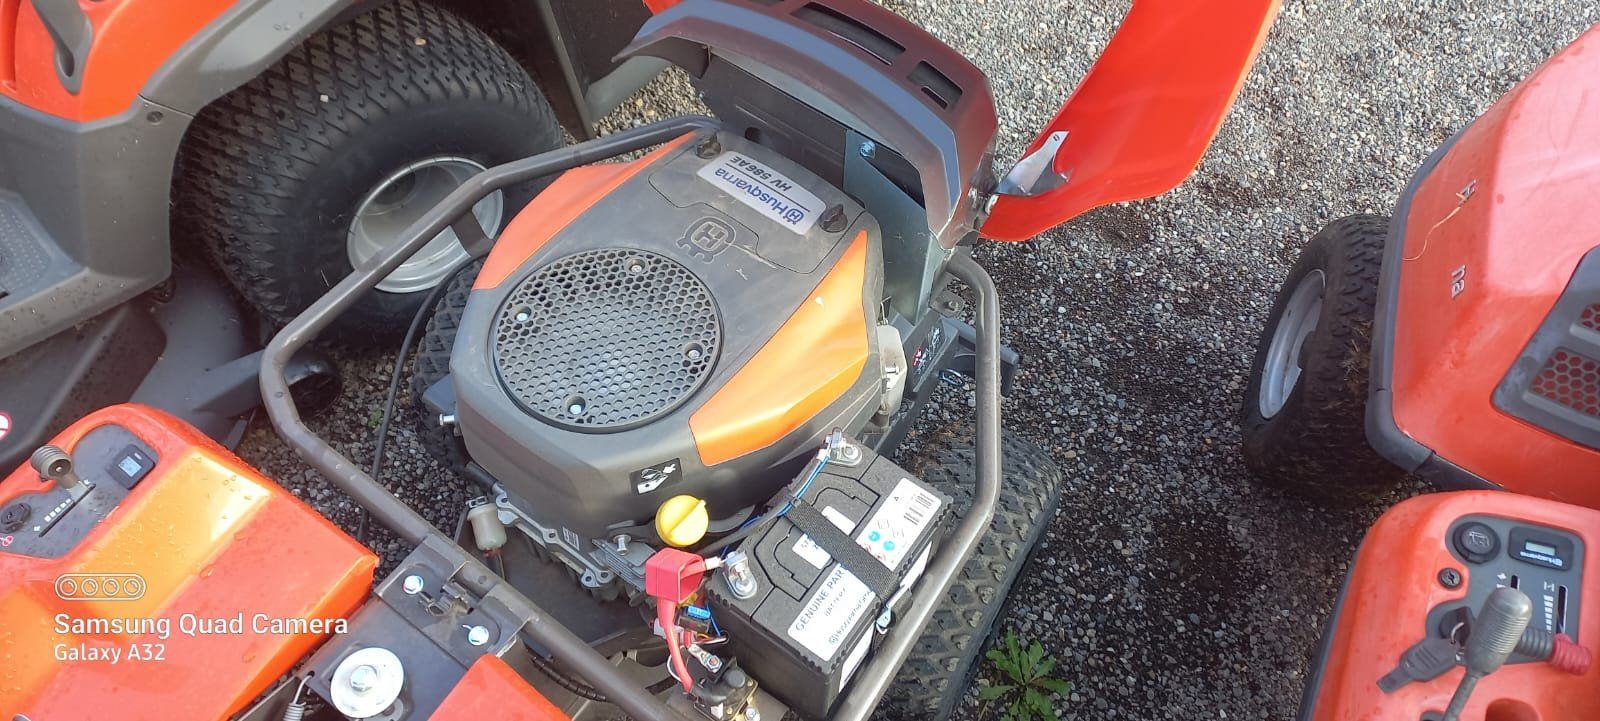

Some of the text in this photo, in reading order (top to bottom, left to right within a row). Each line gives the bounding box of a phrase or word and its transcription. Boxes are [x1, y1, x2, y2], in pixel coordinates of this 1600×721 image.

[714, 167, 789, 215] Husqvarna
[730, 156, 792, 192] HV 586AE
[796, 589, 829, 632] GENUINE
